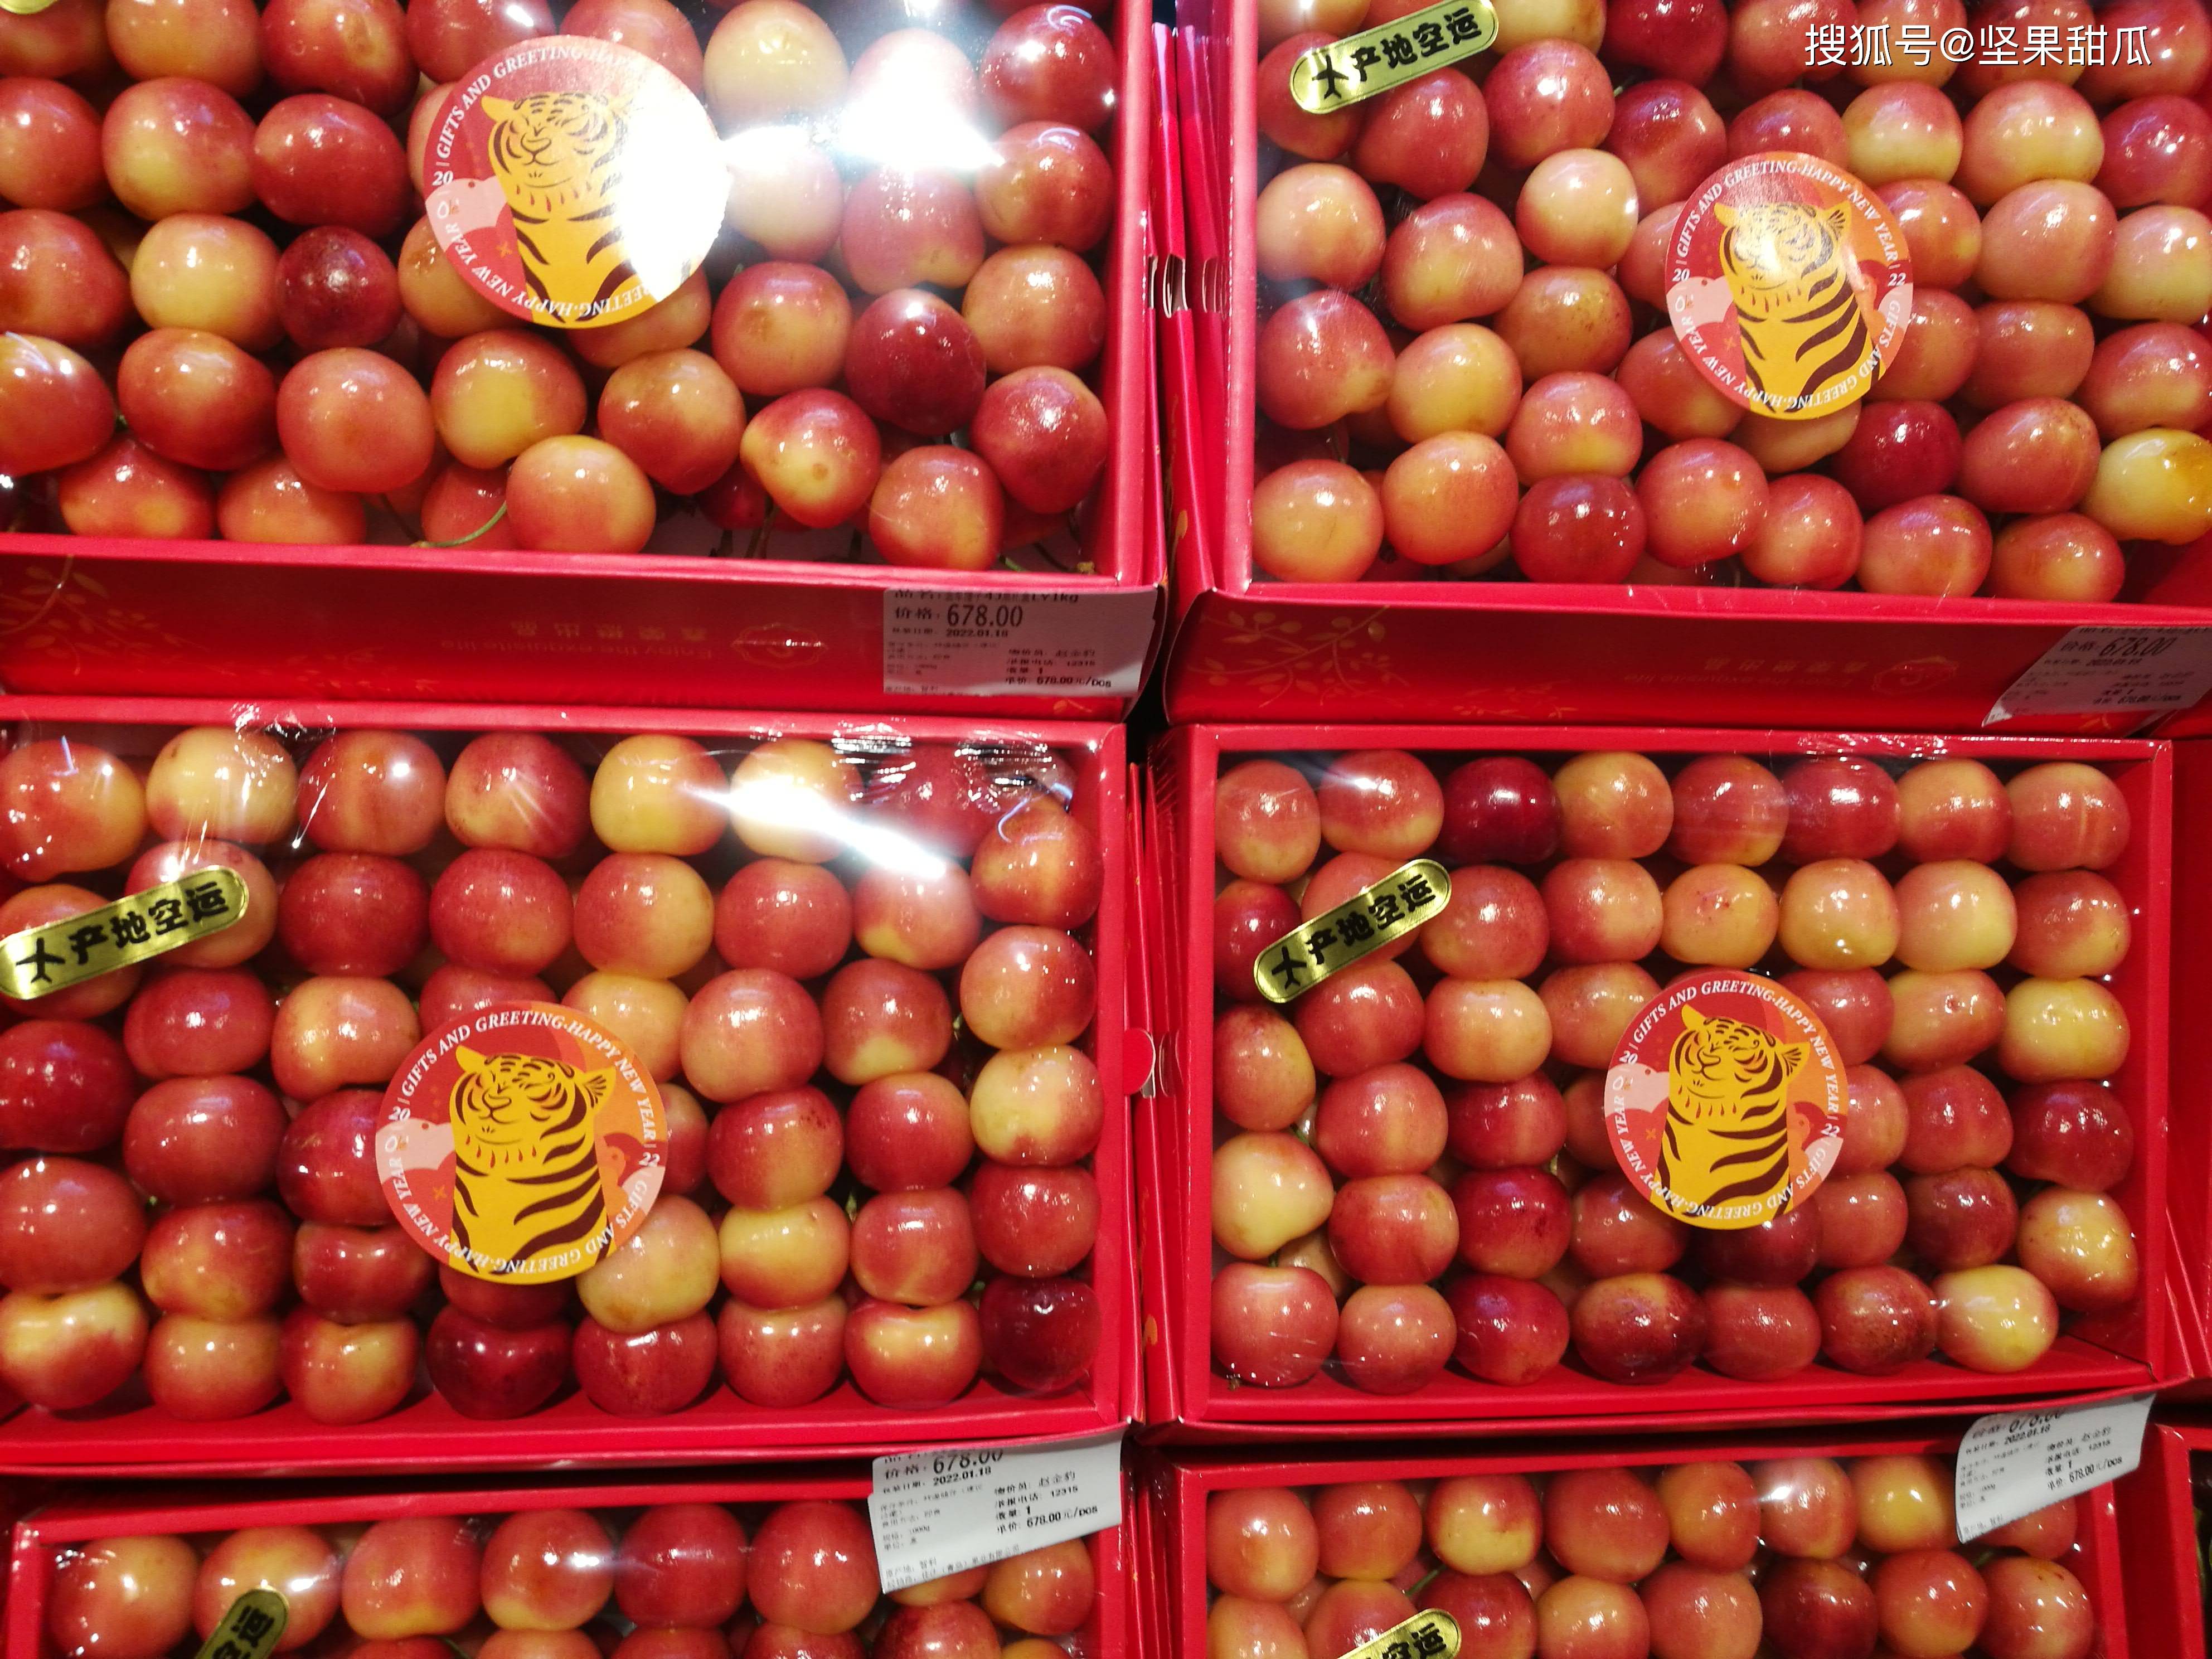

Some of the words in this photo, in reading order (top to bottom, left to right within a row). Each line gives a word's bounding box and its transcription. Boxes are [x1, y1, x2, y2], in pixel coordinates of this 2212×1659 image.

[1351, 7, 1481, 82] 产地空运
[436, 105, 465, 159] GIFTS
[463, 74, 491, 110] AND
[433, 171, 453, 186] 20
[1677, 212, 1700, 258] GIFTS
[1698, 183, 1723, 215] AND
[1847, 188, 1881, 220] NEW
[1873, 221, 1897, 263] YEAR
[445, 221, 476, 265] YEAR
[472, 266, 514, 296] NEW
[1672, 269, 1690, 282] 20
[1888, 273, 1907, 286] 22
[1681, 317, 1707, 355] YEAR
[1879, 300, 1900, 347] GIFTS
[1702, 356, 1736, 385] NEW
[1859, 347, 1881, 379] AND
[947, 603, 1023, 627] 678.00
[2099, 636, 2177, 657] 678.00
[69, 881, 230, 965] 产地空运
[1306, 874, 1436, 965] 产地空运
[1619, 1051, 1637, 1064] 20
[1633, 1003, 1666, 1044] GIFTS
[1669, 986, 1697, 1011] AND
[1810, 1035, 1835, 1070] NEW
[1825, 1074, 1839, 1112] YEAR
[401, 1047, 438, 1098] GIFTS
[437, 1024, 471, 1052] AND
[615, 1056, 647, 1093] NEW
[636, 1097, 657, 1141] YEAR
[389, 1106, 410, 1120] 20
[1614, 1095, 1628, 1135] YEAR
[1821, 1124, 1840, 1137] 22
[639, 1152, 659, 1167] 22
[1620, 1138, 1646, 1173] NEW
[1796, 1148, 1826, 1189] GIFTS
[390, 1157, 413, 1201] YEAR
[615, 1180, 647, 1229] GIFTS
[1766, 1184, 1794, 1209] AND
[403, 1202, 440, 1237] NEW
[585, 1224, 615, 1254] AND
[933, 1467, 991, 1486] 2022.01.18
[1050, 1485, 1078, 1498] 12315
[1026, 1506, 1031, 1515] 1
